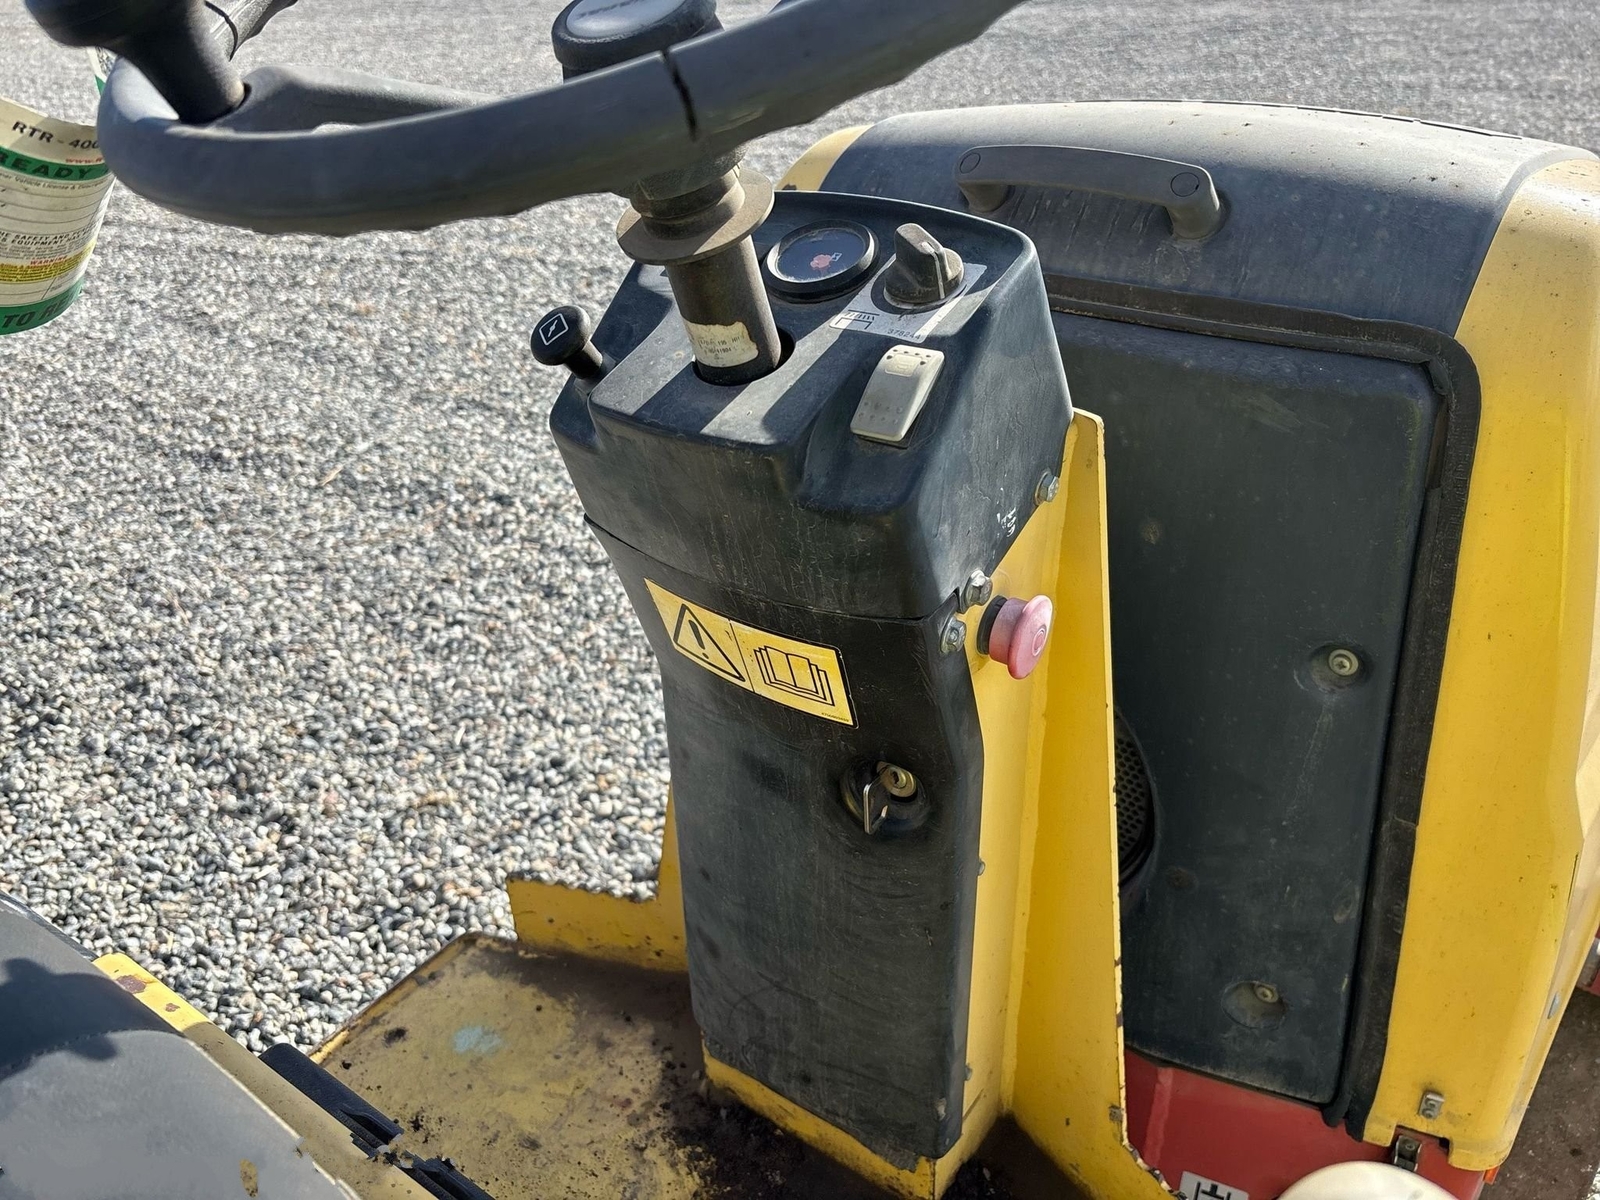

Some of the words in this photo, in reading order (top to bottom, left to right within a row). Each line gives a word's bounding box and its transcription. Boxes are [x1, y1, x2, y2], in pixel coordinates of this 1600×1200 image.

[12, 121, 54, 143] RTR
[11, 239, 63, 247] EQUIPMENT
[2, 311, 36, 328] TO
[887, 327, 921, 340] 378244
